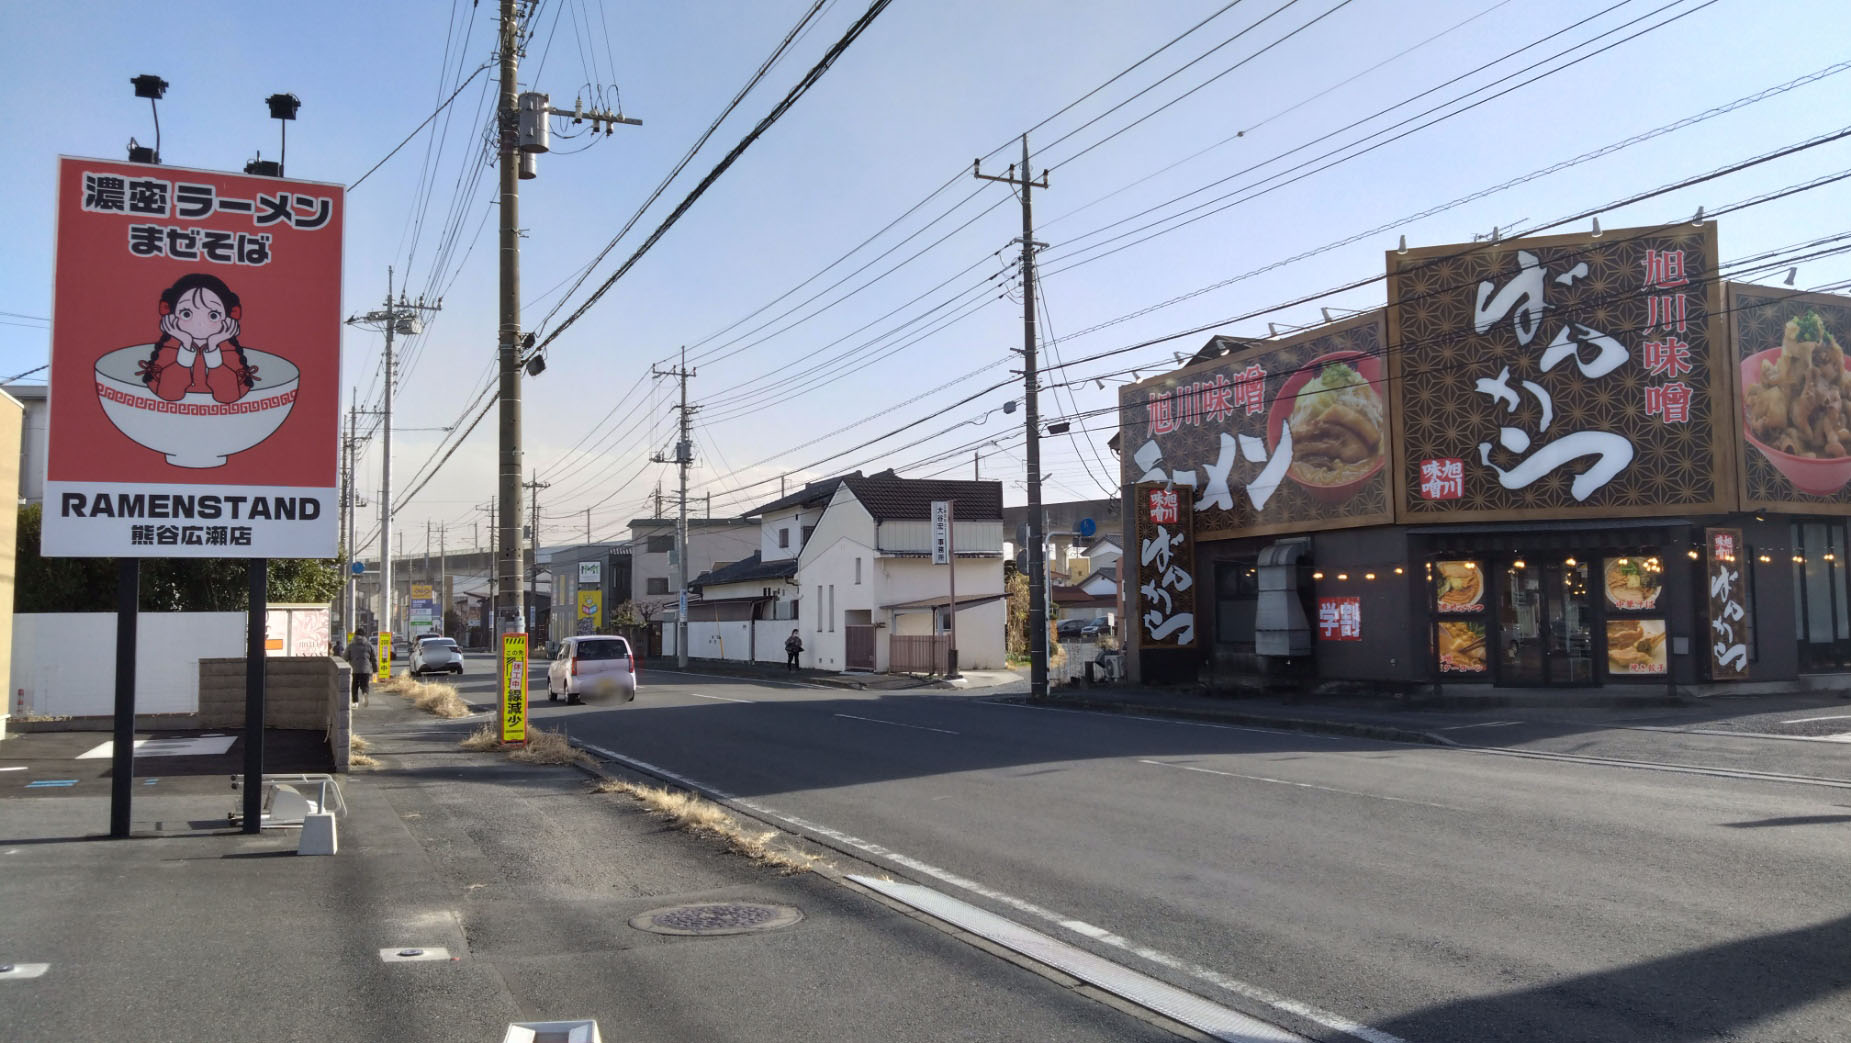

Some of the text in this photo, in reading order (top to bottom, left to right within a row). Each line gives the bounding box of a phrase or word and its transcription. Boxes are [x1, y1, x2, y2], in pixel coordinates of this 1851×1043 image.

[84, 173, 331, 229] 濃密ラーメン
[130, 225, 271, 264] まぜそば
[61, 493, 321, 520] RAMENSTAND
[131, 525, 252, 546] 熊谷広瀬店
[1319, 602, 1360, 637] 学割
